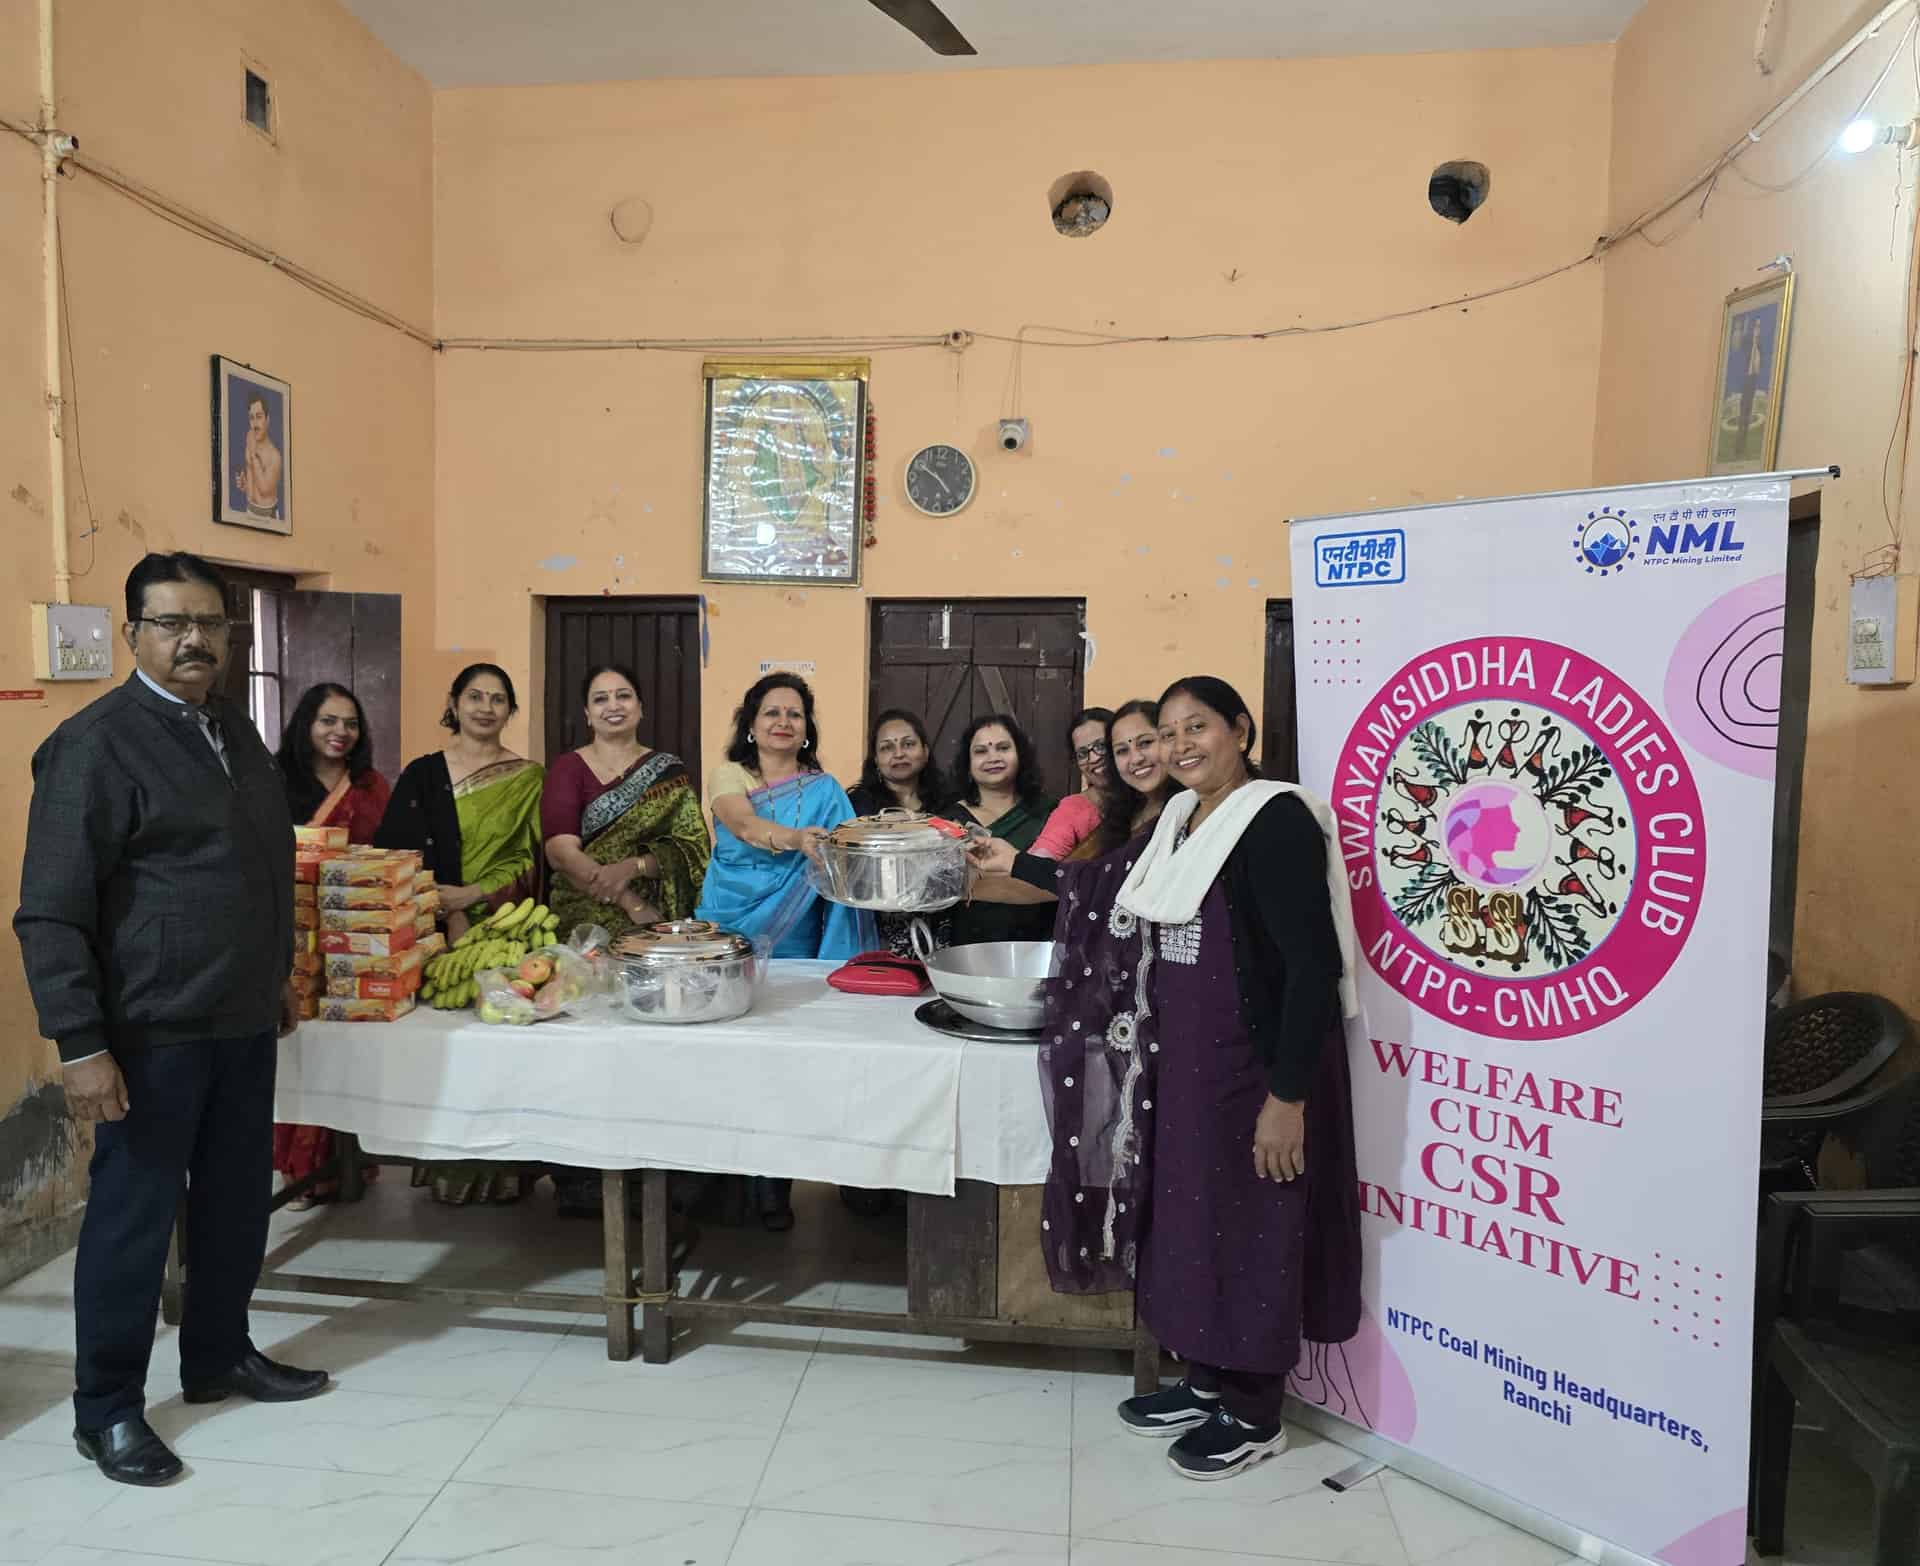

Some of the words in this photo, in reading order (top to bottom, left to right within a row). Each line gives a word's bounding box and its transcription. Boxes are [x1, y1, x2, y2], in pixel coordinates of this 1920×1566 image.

[1322, 537, 1397, 564] एनटीपीसी
[1327, 560, 1393, 580] NTPC
[1643, 557, 1670, 567] NTPC
[1672, 555, 1703, 566] Mining
[1705, 553, 1743, 563] Limited
[1646, 521, 1745, 555] NML
[1341, 645, 1538, 890] SWAYAMSIDDHA
[1550, 658, 1680, 795] LADIES
[1640, 812, 1696, 937] CLUB
[1369, 929, 1630, 1029] NTPC-CMHQ
[1369, 1038, 1624, 1129] WELFARE
[1429, 1097, 1554, 1160] CUM
[1420, 1141, 1566, 1226] CSR
[1359, 1180, 1641, 1300] INITIATIVE
[1387, 1306, 1434, 1342] NTPC
[1438, 1327, 1479, 1360] Coal
[1484, 1343, 1548, 1391] Mining
[1553, 1369, 1710, 1454] Headquarters,
[1503, 1379, 1573, 1426] Ranchi
